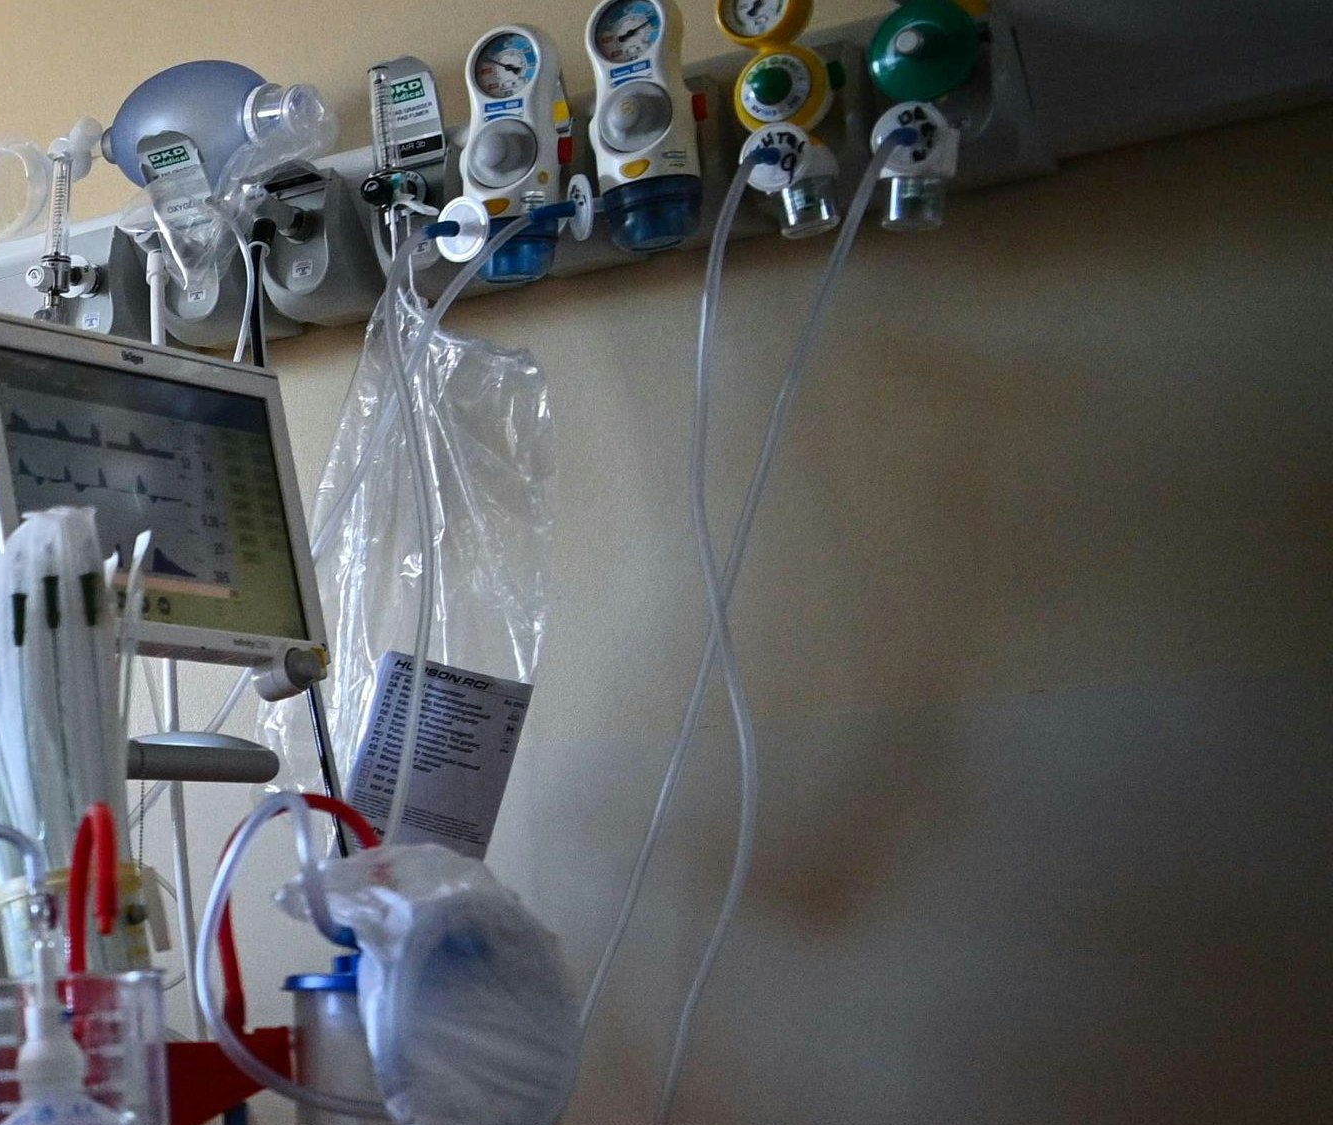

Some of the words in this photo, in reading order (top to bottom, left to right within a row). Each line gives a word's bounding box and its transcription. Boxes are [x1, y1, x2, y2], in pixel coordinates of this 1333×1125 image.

[394, 89, 424, 101] édical
[148, 148, 185, 162] DKD
[394, 659, 462, 684] HUSON
[463, 677, 491, 690] RCI
